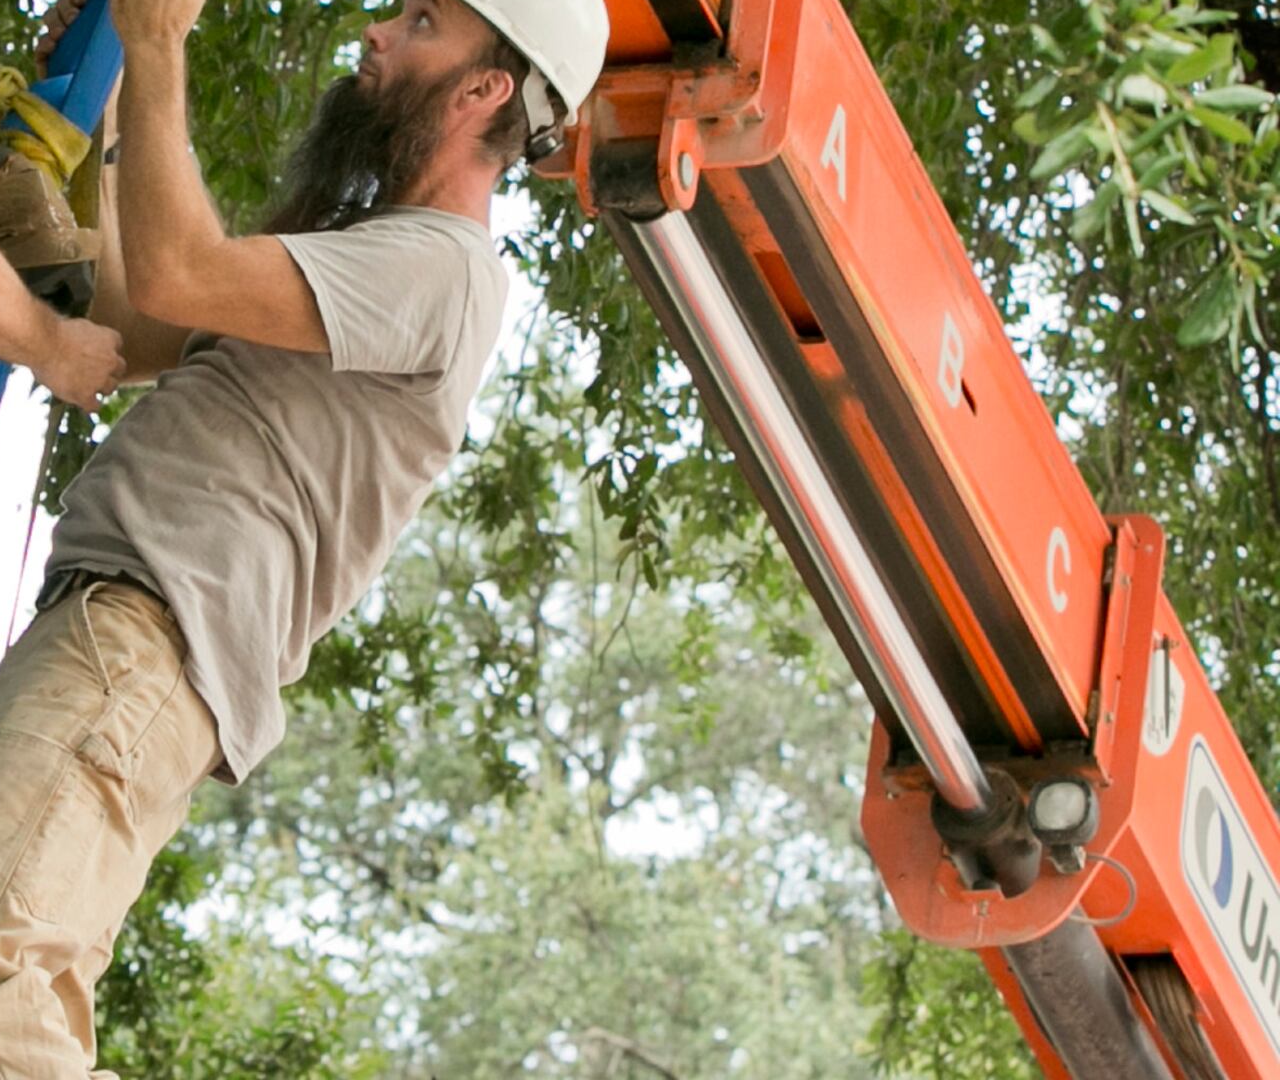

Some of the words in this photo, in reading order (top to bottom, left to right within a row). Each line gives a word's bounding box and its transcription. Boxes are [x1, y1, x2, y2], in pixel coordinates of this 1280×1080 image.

[820, 103, 846, 204] A
[937, 311, 964, 408] B
[1046, 526, 1072, 613] C
[1239, 870, 1280, 1016] Un
